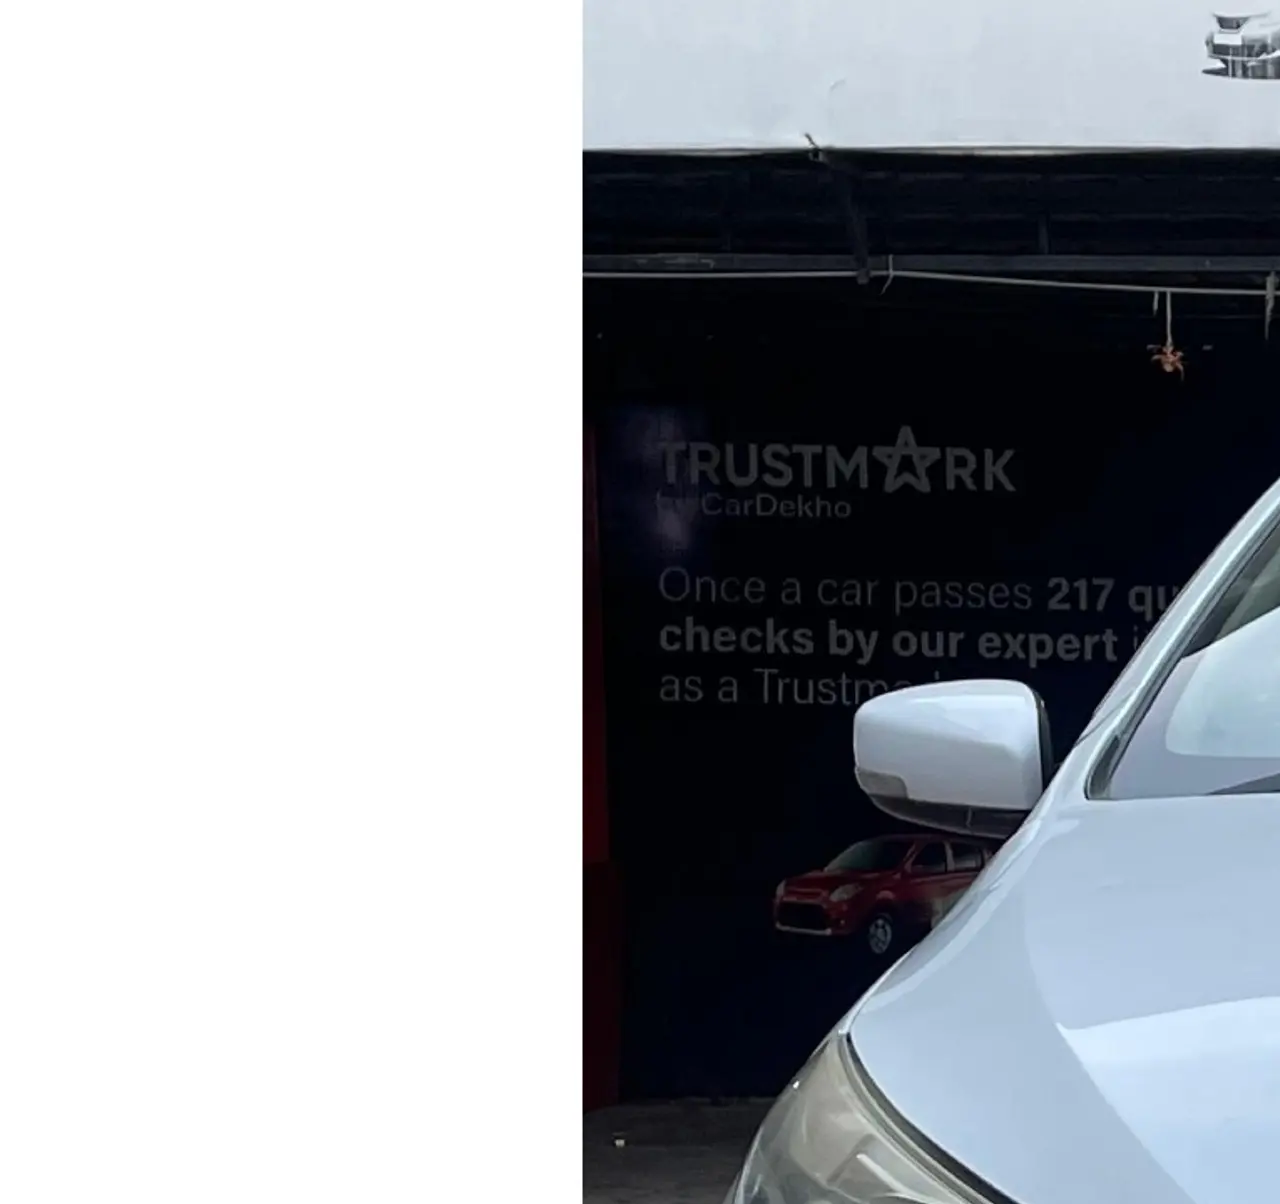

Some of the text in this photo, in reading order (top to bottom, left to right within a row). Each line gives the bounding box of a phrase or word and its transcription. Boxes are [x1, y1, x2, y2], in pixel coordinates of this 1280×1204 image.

[700, 491, 852, 519] CarDekho
[658, 565, 767, 603] Once
[780, 577, 802, 605] a
[817, 578, 880, 606] car
[894, 580, 1033, 616] passes
[1047, 577, 1116, 612] 217
[658, 615, 815, 655] checks
[828, 618, 879, 665] by
[891, 629, 966, 658] our
[977, 629, 1118, 668] expert
[658, 674, 704, 702] as
[717, 676, 739, 703] a
